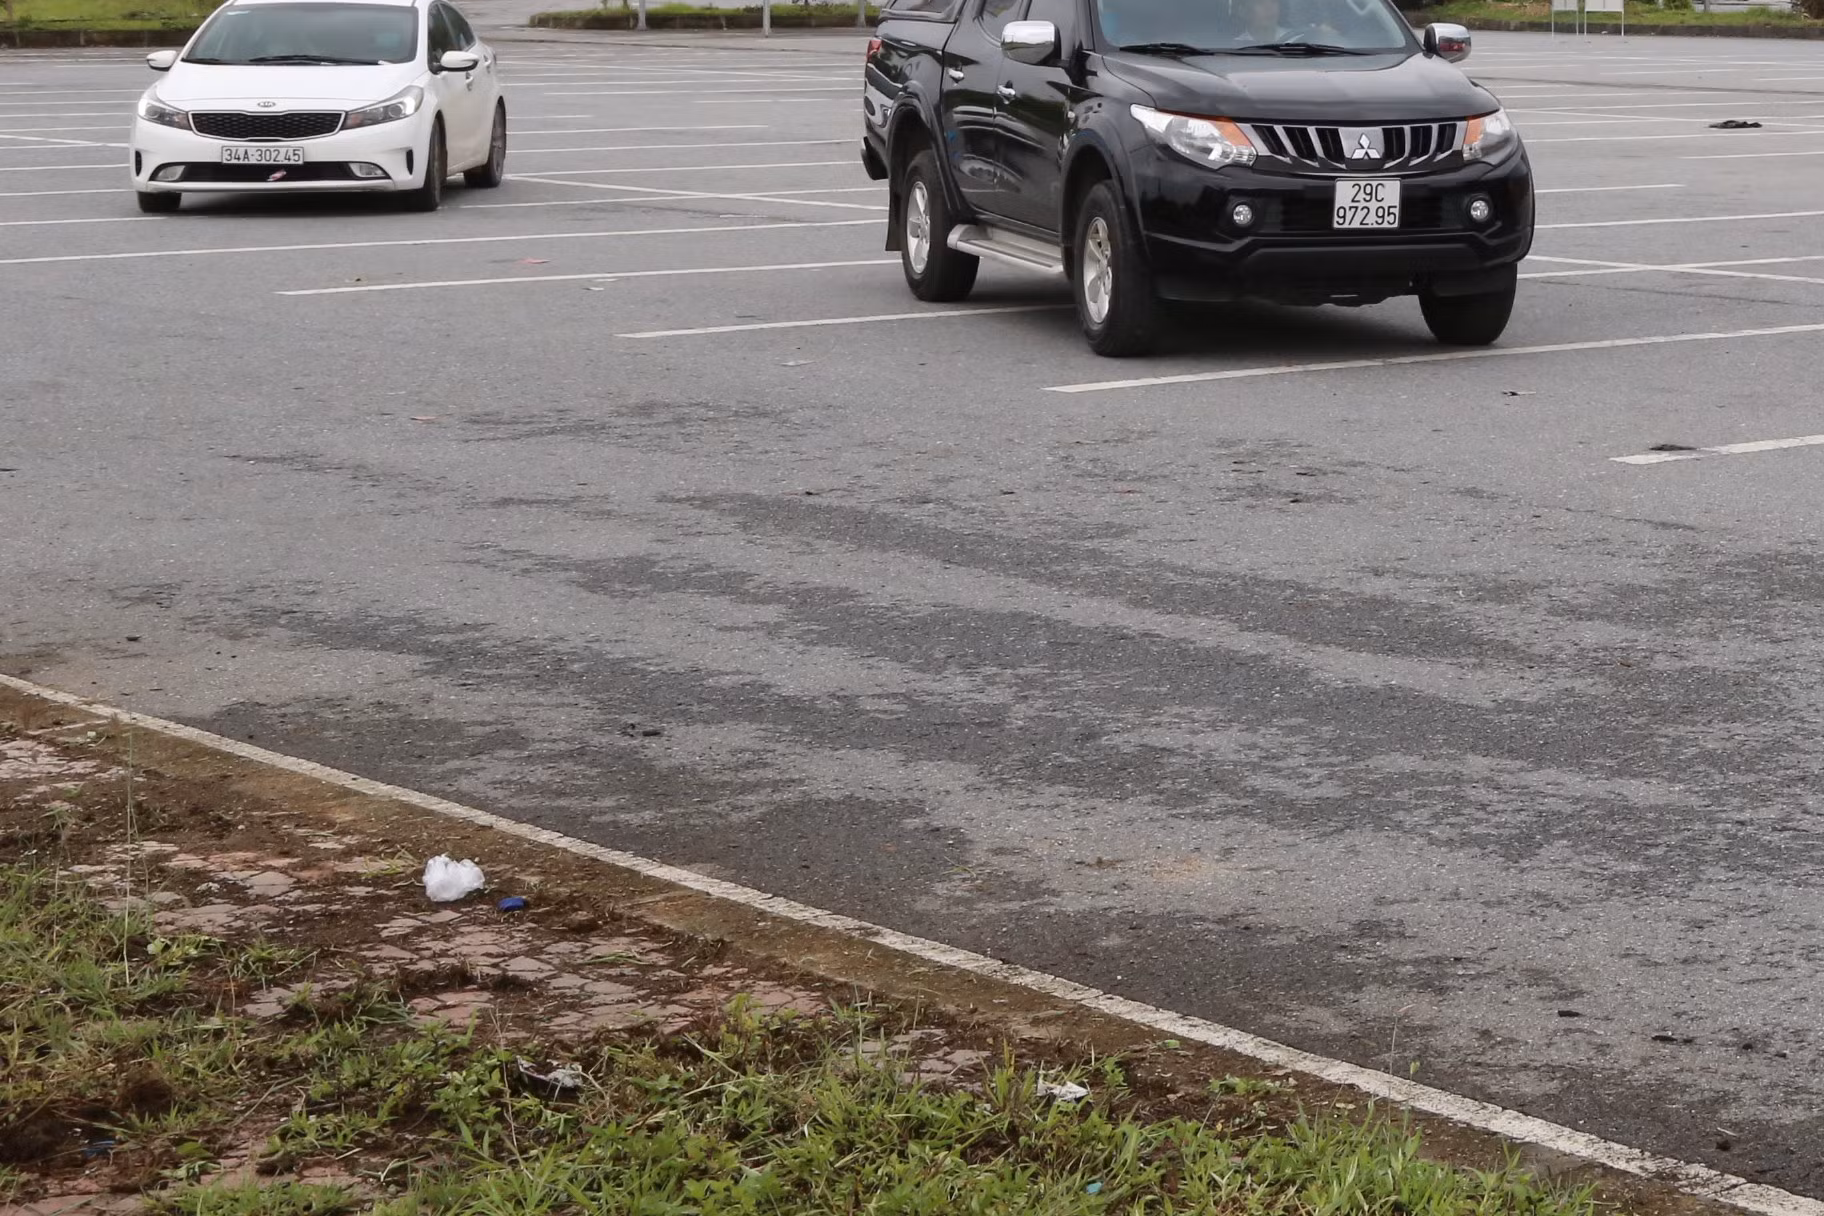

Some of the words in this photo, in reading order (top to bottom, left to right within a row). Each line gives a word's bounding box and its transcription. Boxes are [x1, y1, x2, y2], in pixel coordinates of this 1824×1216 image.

[224, 148, 301, 163] 34A-302.45
[1351, 183, 1385, 203] 29C
[1335, 205, 1398, 226] 972.95
